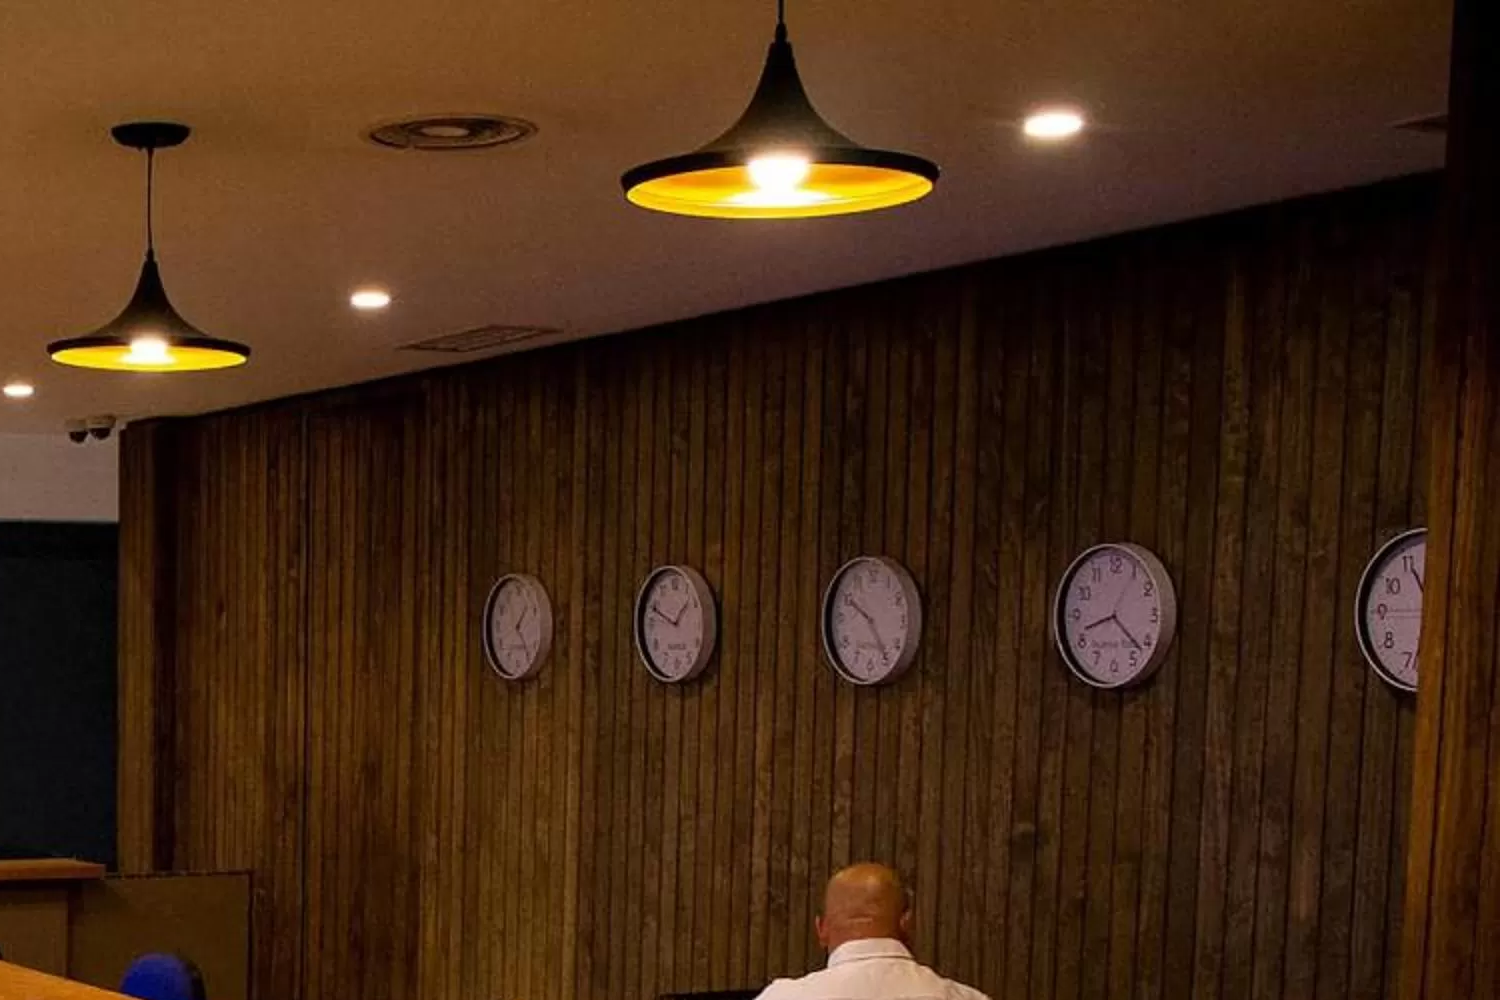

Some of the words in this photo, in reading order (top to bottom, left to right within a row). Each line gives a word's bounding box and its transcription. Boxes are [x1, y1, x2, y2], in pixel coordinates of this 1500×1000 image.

[1109, 555, 1123, 574] 12
[1131, 562, 1137, 580] 1
[1402, 555, 1414, 573] 11
[1091, 567, 1101, 583] 11
[1143, 581, 1153, 597] 2
[1386, 577, 1401, 595] 10
[1150, 607, 1158, 623] 3
[1377, 603, 1388, 620] 9
[1143, 633, 1152, 648] 4
[1383, 631, 1395, 649] 8
[1091, 650, 1101, 666] 7
[1109, 658, 1119, 673] 6
[1129, 650, 1138, 667] 5
[1401, 651, 1412, 669] 7
